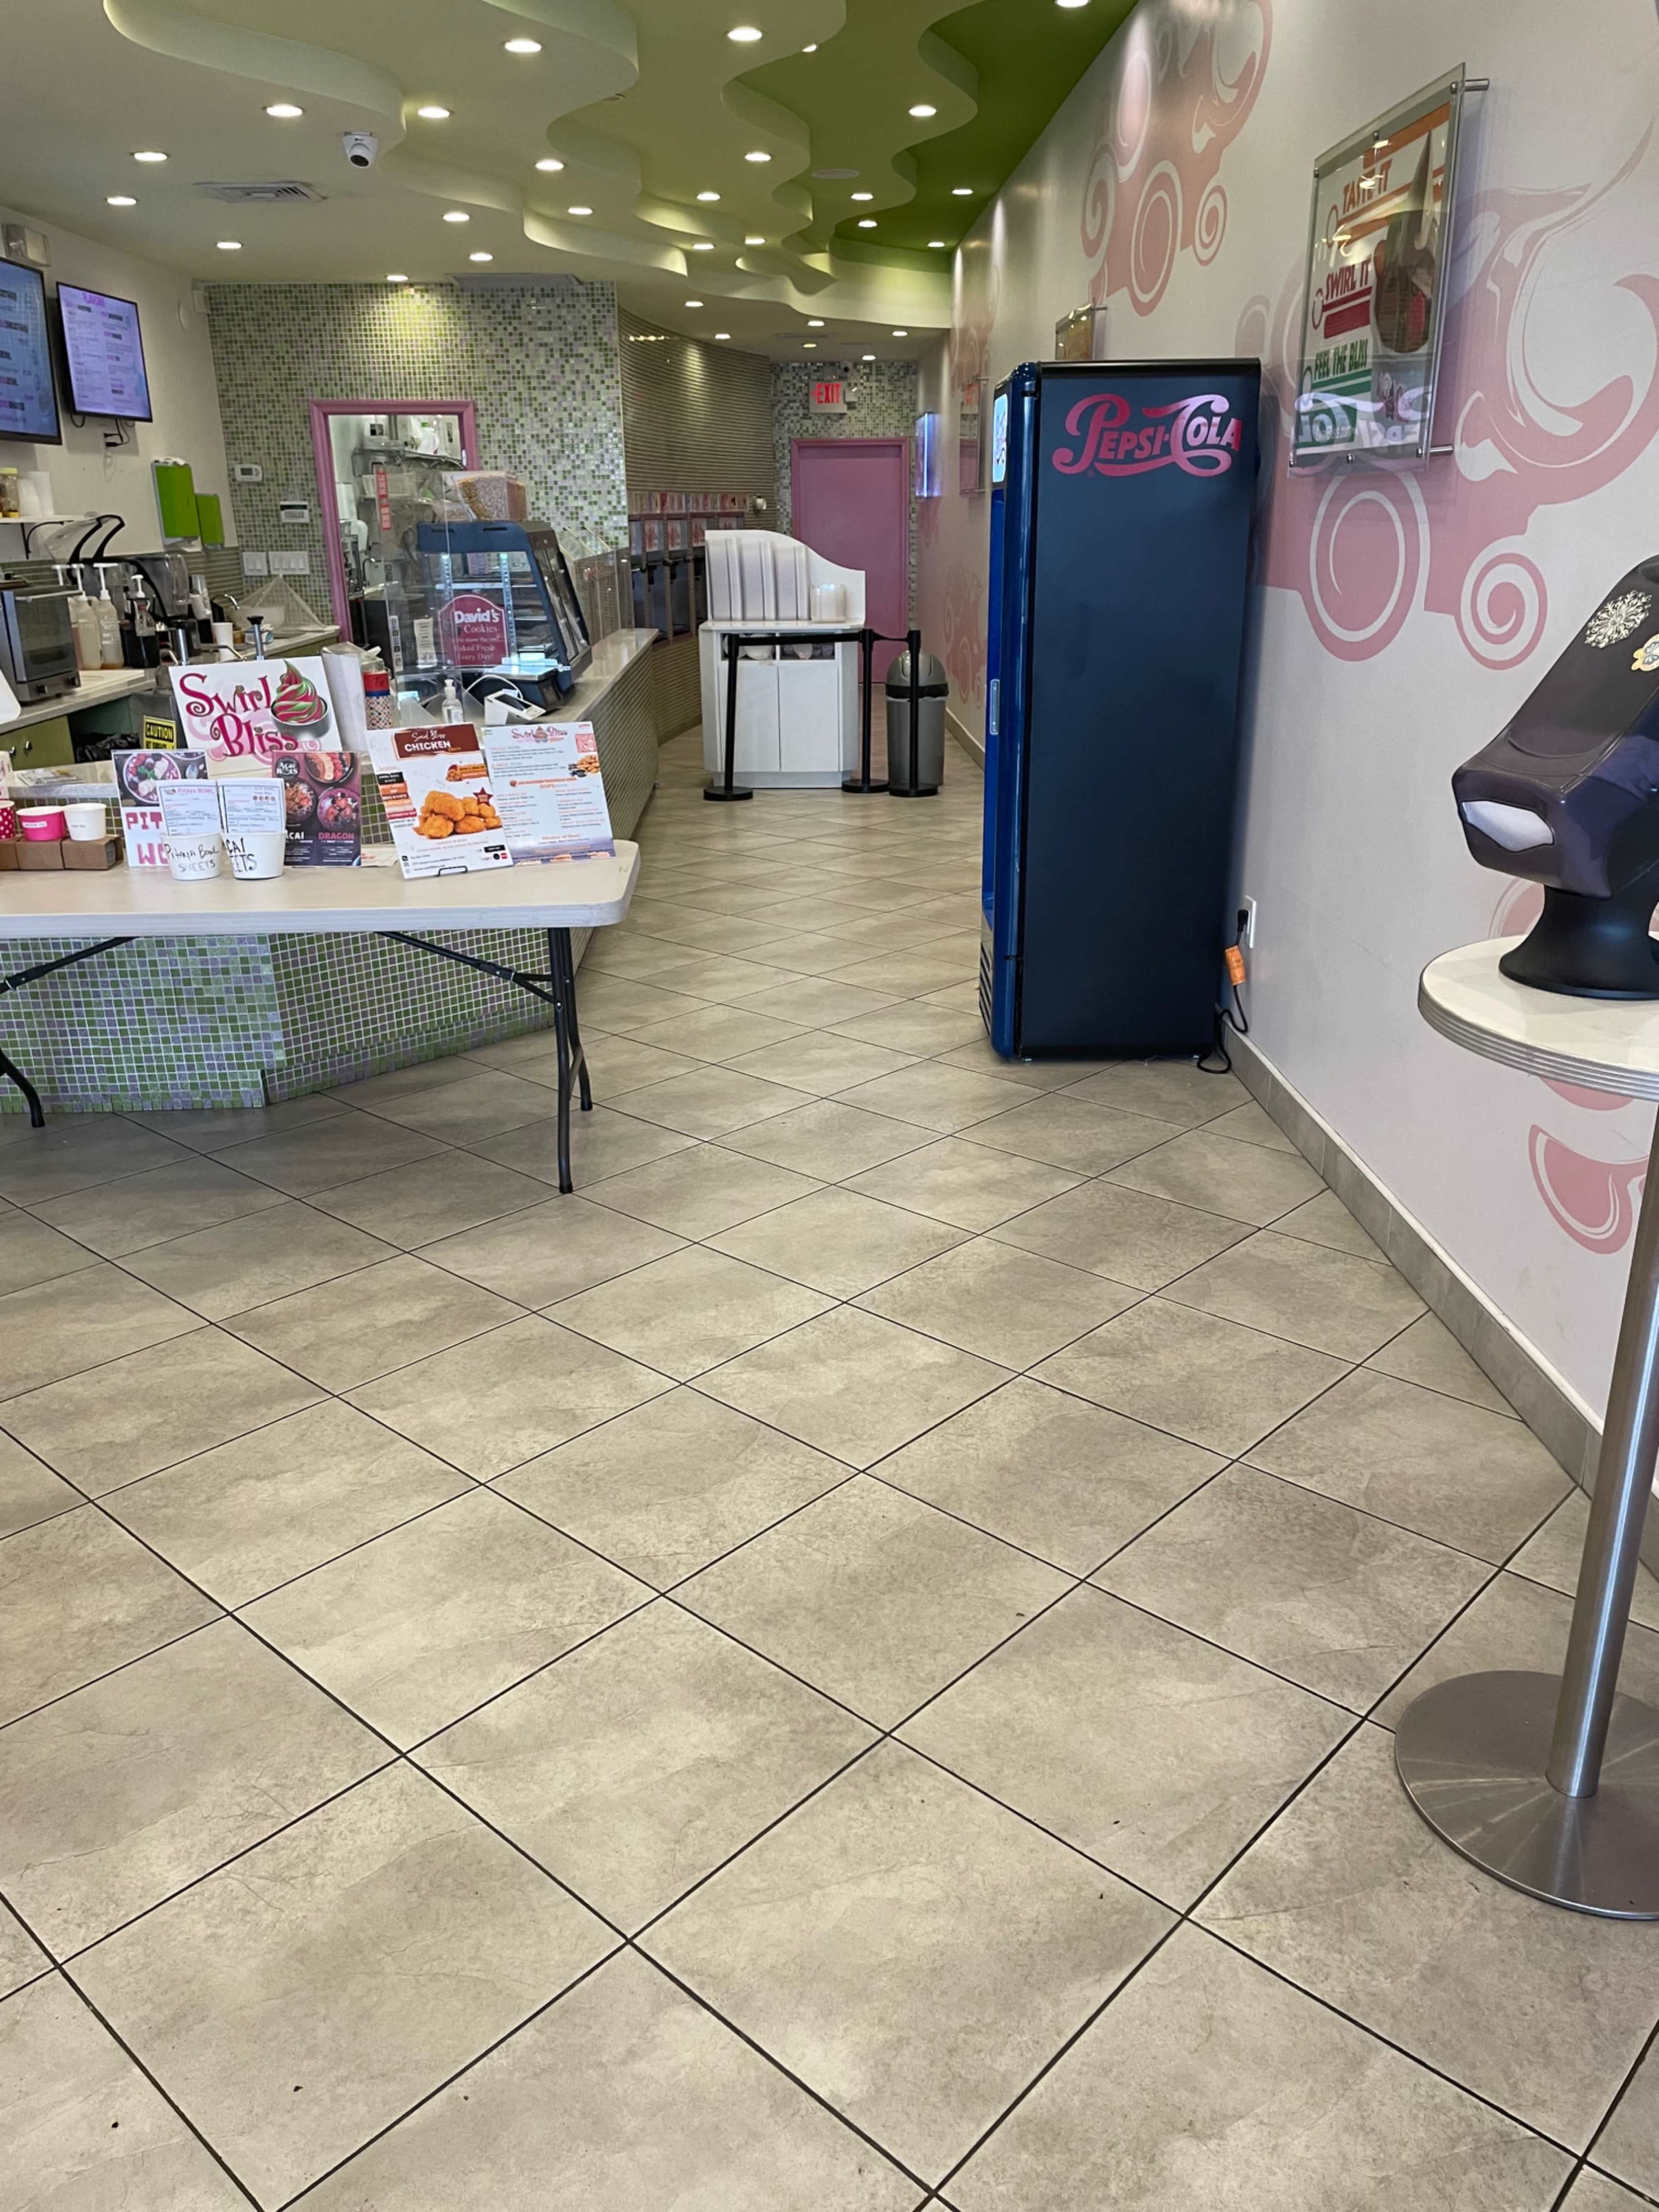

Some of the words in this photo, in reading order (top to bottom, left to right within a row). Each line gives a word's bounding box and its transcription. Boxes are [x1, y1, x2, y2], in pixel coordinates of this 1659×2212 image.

[1378, 157, 1392, 195] IT
[1326, 264, 1356, 300] SWIRL
[1360, 254, 1373, 287] IT
[1333, 344, 1348, 375] THE
[1348, 338, 1368, 372] BLISS
[816, 382, 840, 404] EXIT
[454, 607, 500, 624] David's
[464, 624, 498, 633] Cookies
[179, 673, 271, 717] Swirl
[146, 724, 173, 740] CAUTION
[210, 713, 299, 757] Bliss
[404, 741, 451, 752] CHICKEN
